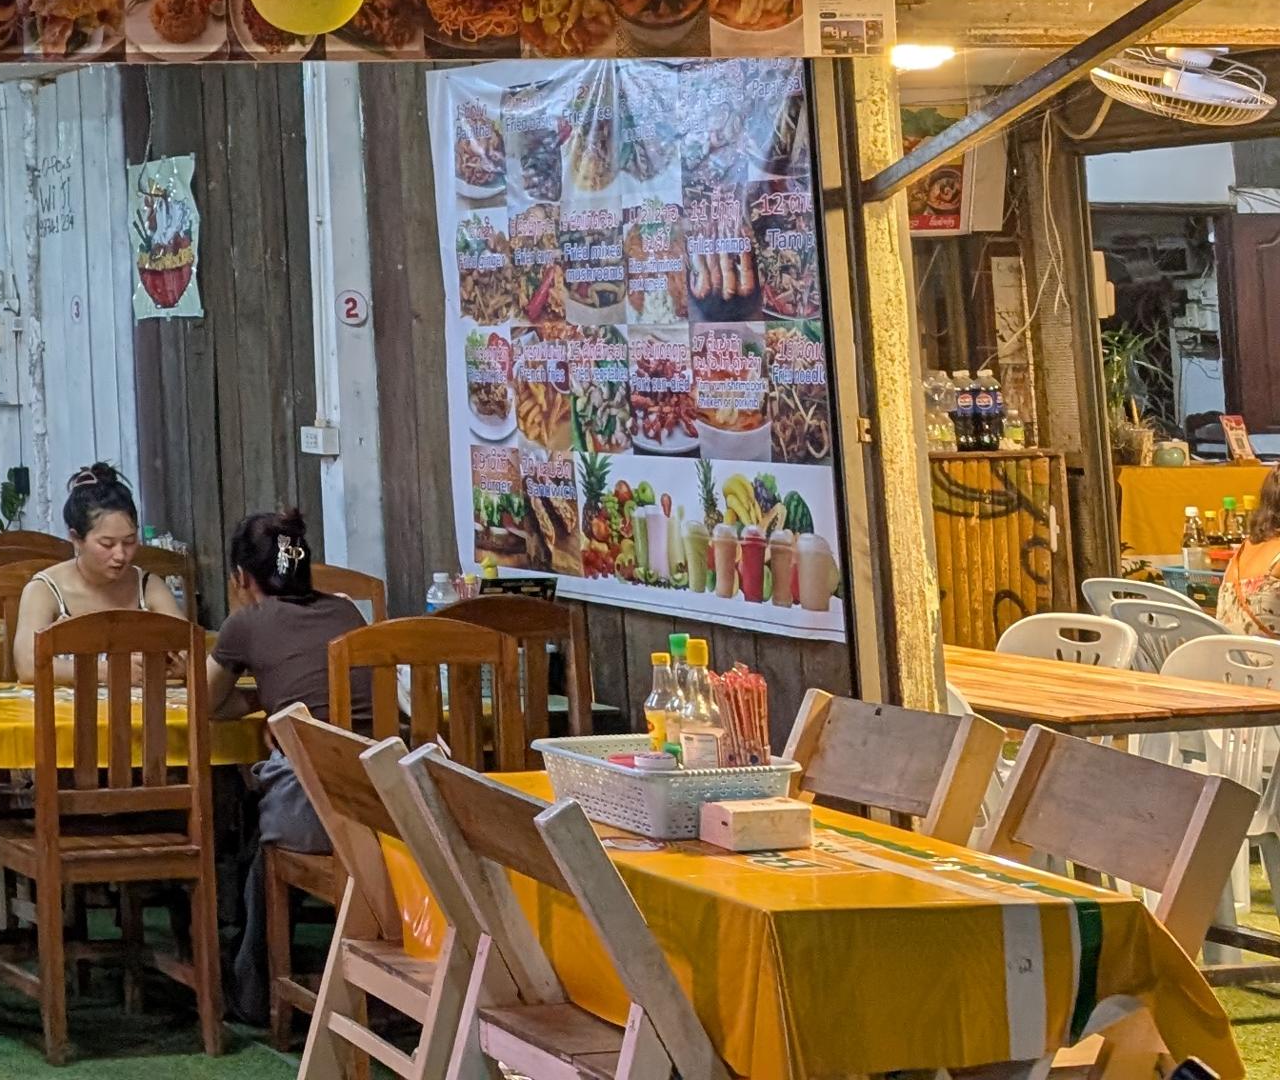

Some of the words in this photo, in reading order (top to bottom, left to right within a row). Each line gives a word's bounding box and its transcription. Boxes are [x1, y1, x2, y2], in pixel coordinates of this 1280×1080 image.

[761, 194, 784, 214] 12
[591, 241, 622, 258] mixed
[566, 266, 624, 282] mushrooms
[344, 296, 359, 319] 2
[480, 474, 512, 494] Burger
[527, 478, 576, 498] Sandwich
